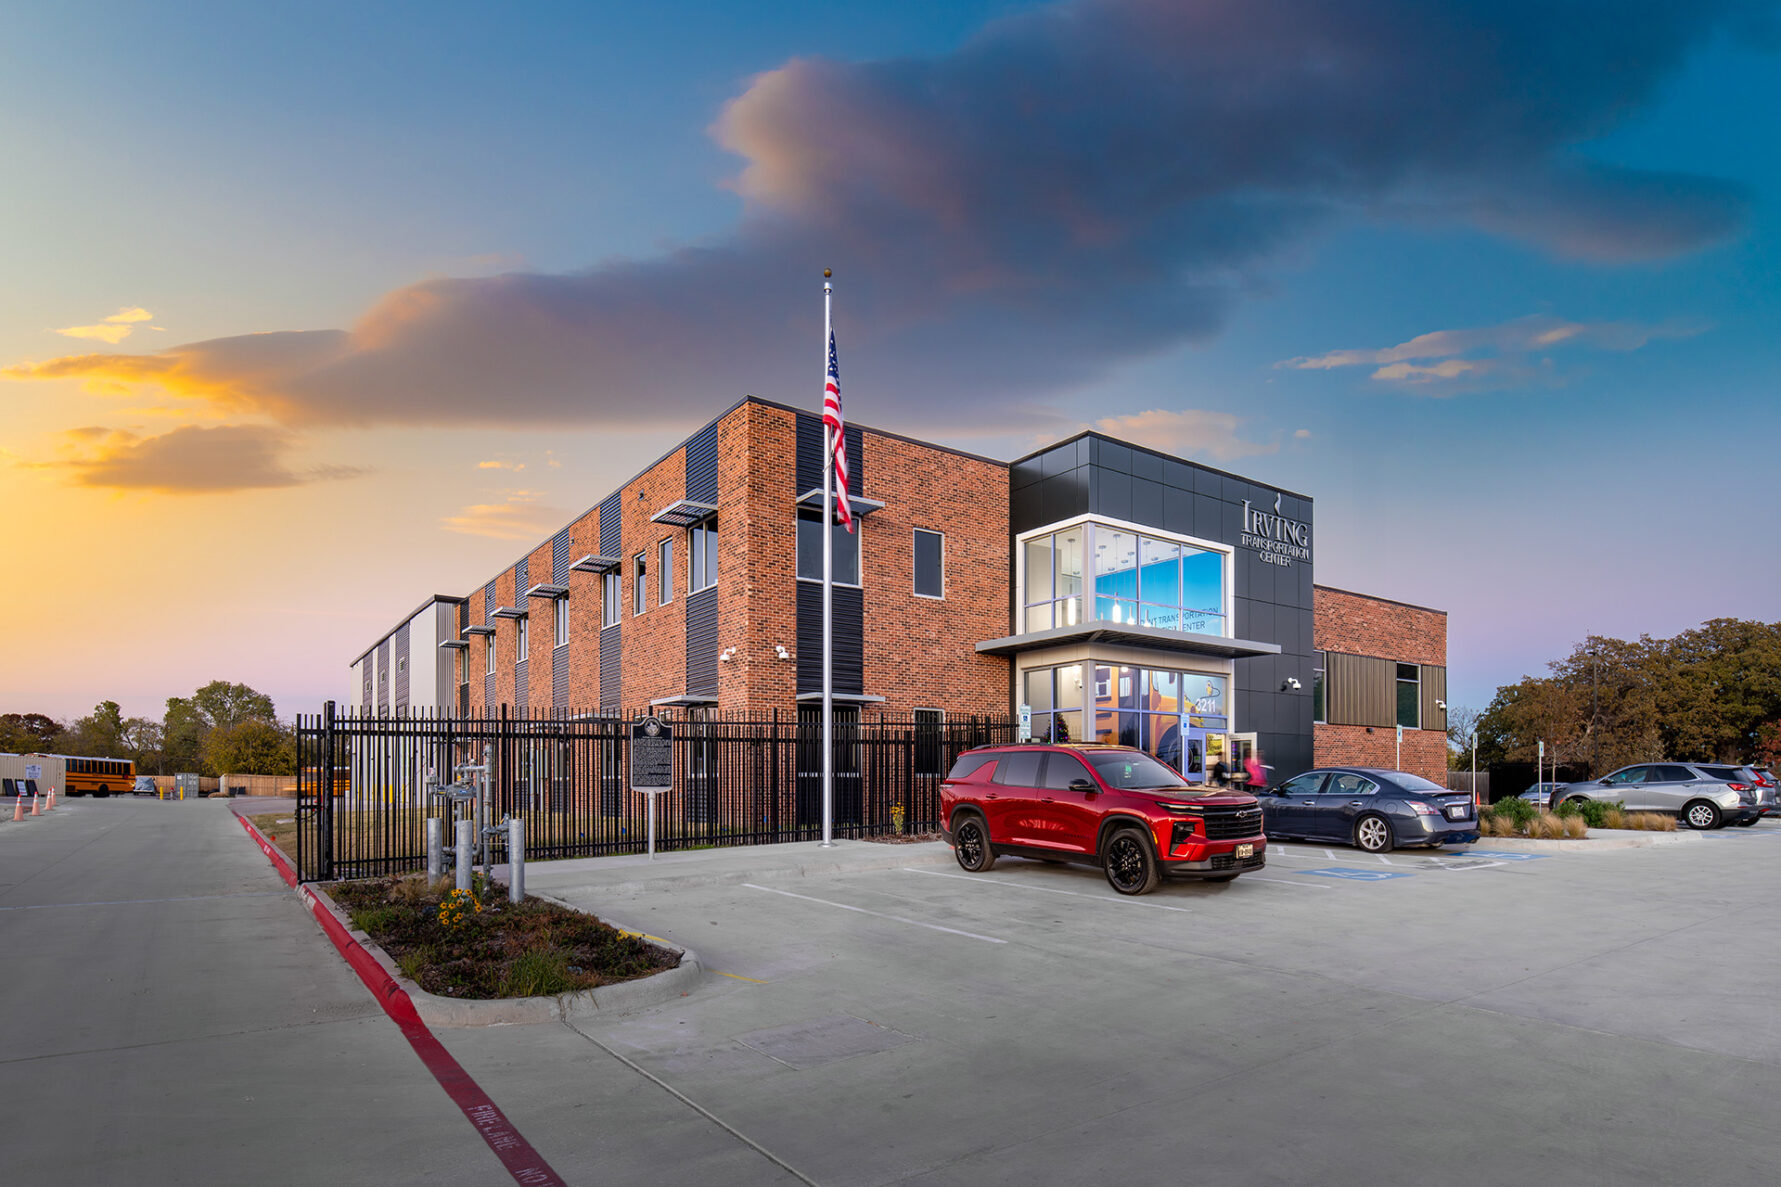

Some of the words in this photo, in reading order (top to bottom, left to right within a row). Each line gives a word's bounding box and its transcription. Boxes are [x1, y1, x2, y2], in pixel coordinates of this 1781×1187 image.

[1241, 498, 1308, 547] IRVING
[1241, 533, 1309, 560] TRANSPORTATION
[1259, 551, 1291, 567] CENTER
[1183, 620, 1206, 632] ENTER
[1195, 698, 1216, 713] 3211
[467, 1105, 502, 1125] FIRE
[482, 1125, 521, 1150] LANE
[515, 1167, 548, 1184] NO
